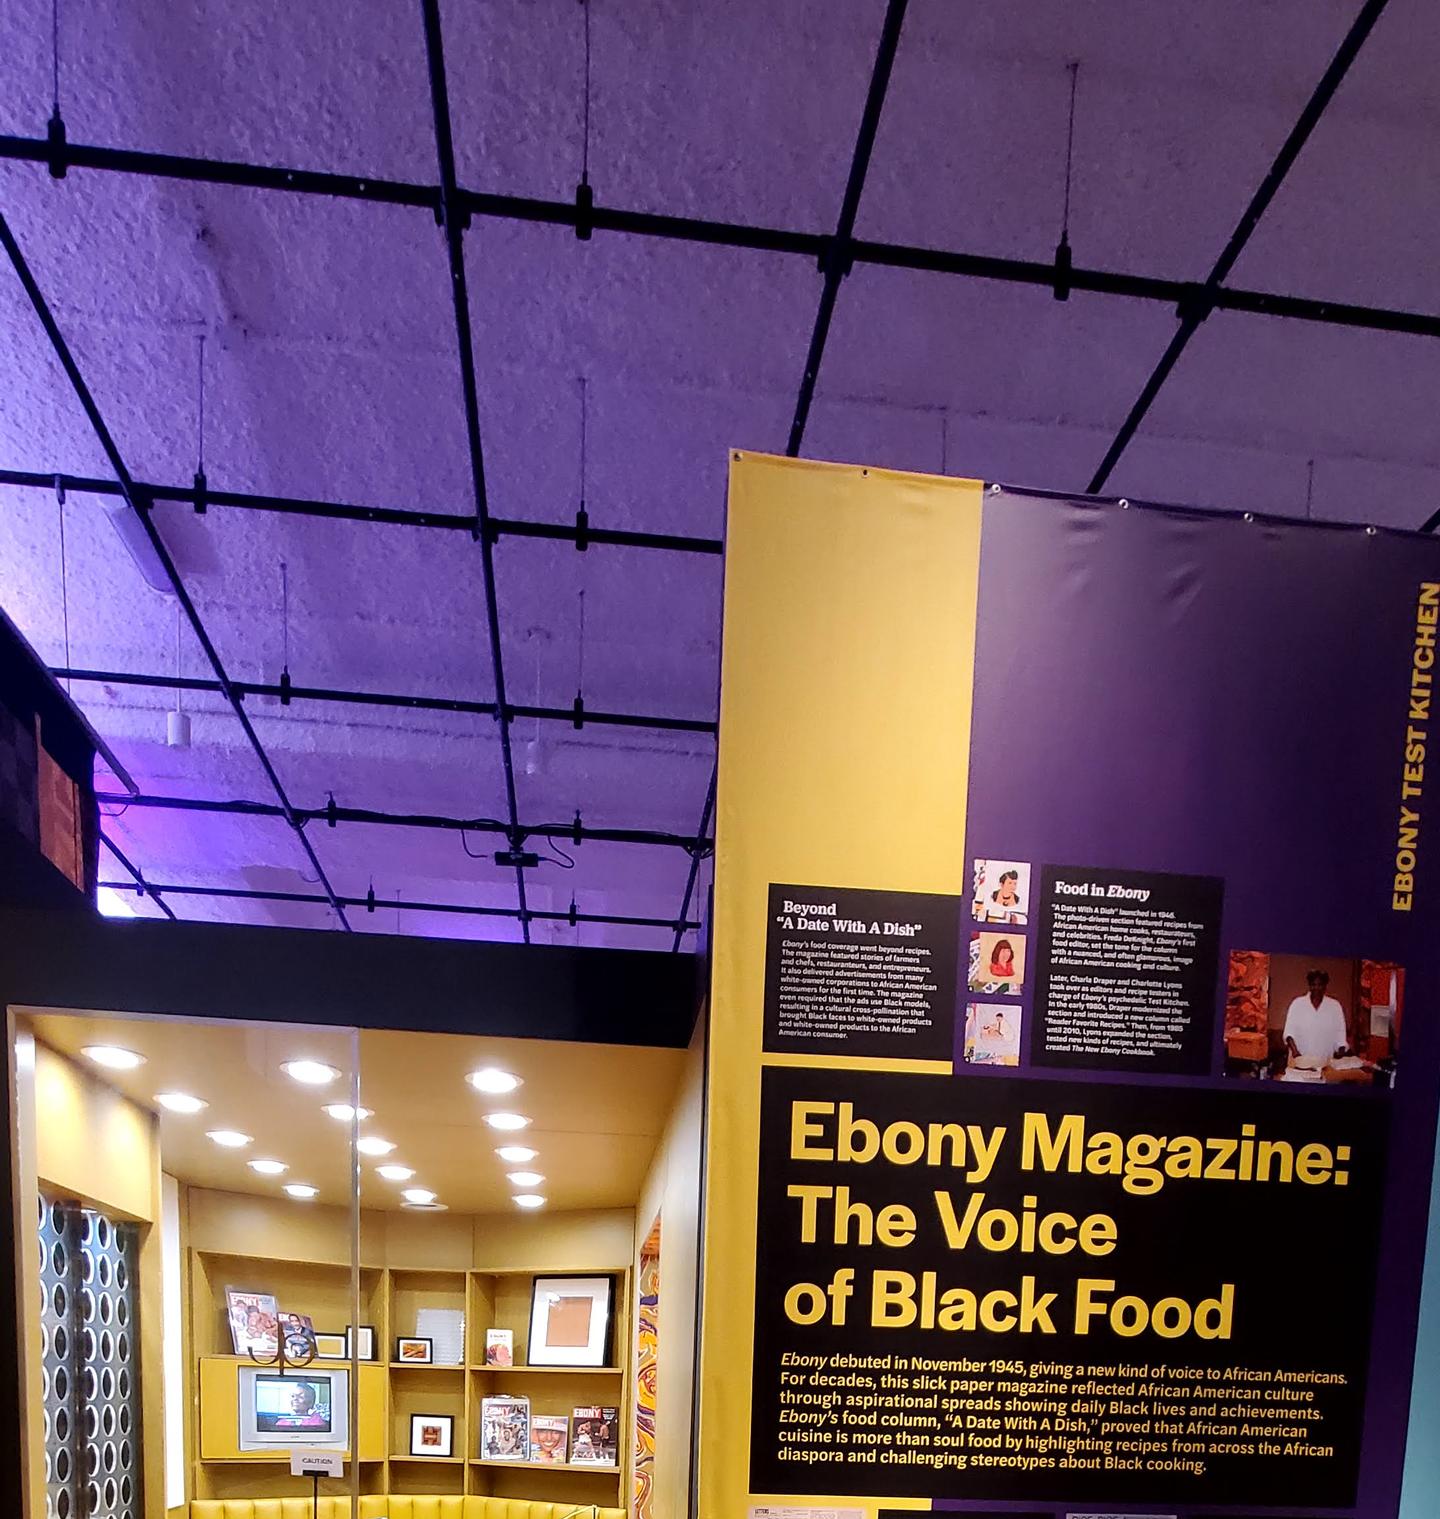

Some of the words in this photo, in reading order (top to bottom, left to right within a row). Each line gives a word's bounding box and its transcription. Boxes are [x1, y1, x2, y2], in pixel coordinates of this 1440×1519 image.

[1408, 582, 1440, 720] KITCHEN
[1402, 725, 1427, 800] TEST
[1392, 806, 1420, 912] EBONY
[1055, 881, 1088, 895] Food
[1090, 883, 1104, 896] in
[1106, 884, 1149, 902] Ebony
[784, 901, 836, 917] Beyond
[777, 916, 793, 928] “A
[797, 917, 829, 931] Date
[832, 920, 866, 933] With
[868, 922, 880, 934] A
[883, 923, 921, 936] Dish”
[782, 940, 808, 949] Ebony’s
[810, 941, 826, 949] food
[827, 944, 858, 952] coverage
[878, 945, 903, 954] beyond
[905, 947, 931, 955] recipes.
[830, 951, 859, 959] featured
[860, 953, 883, 961] stories
[893, 955, 919, 963] farmers
[781, 976, 824, 984] white-owned
[826, 979, 869, 987] corporations
[904, 982, 936, 990] American
[791, 1101, 1006, 1183] Ebony
[1022, 1112, 1350, 1199] Magazine:
[787, 1185, 916, 1247] The
[934, 1191, 1117, 1255] Voice
[784, 1268, 854, 1325] of
[871, 1270, 1058, 1333] Black
[1075, 1279, 1234, 1339] Food
[781, 1353, 827, 1371] Ebony
[830, 1355, 890, 1369] debuted
[894, 1357, 907, 1370] in
[911, 1357, 986, 1372] November
[988, 1360, 1026, 1375] 1945,
[1029, 1361, 1073, 1379] giving
[1075, 1366, 1083, 1375] a
[1087, 1366, 1115, 1376] new
[1118, 1364, 1147, 1377] kind
[1151, 1365, 1165, 1378] of
[1168, 1366, 1203, 1379] voice
[1207, 1367, 1220, 1380] to
[1223, 1367, 1270, 1381] African
[1274, 1369, 1346, 1384] Americans.
[781, 1373, 805, 1386] For
[809, 1374, 876, 1390] decades,
[880, 1376, 908, 1389] this
[912, 1377, 946, 1390] slick
[950, 1381, 994, 1395] paper
[997, 1380, 1067, 1396] magazine
[1071, 1382, 1134, 1395] reflected
[1138, 1383, 1189, 1397] African
[1193, 1385, 1260, 1399] American
[1265, 1387, 1313, 1400] culture
[574, 1408, 601, 1418] EBONY
[780, 1392, 840, 1410] through
[846, 1394, 937, 1411] aspirational
[941, 1398, 1000, 1413] spreads
[1004, 1399, 1067, 1416] showing
[1071, 1400, 1105, 1418] daily
[1110, 1401, 1148, 1415] Black
[1153, 1402, 1185, 1416] lives
[1190, 1404, 1215, 1417] and
[1220, 1405, 1322, 1420] achievements.
[780, 1410, 838, 1428] Ebony’s
[842, 1412, 876, 1425] food
[880, 1414, 940, 1429] column,
[945, 1415, 962, 1428] “A
[966, 1415, 1000, 1429] Date
[1004, 1416, 1036, 1430] With
[1040, 1417, 1050, 1430] A
[1054, 1418, 1097, 1433] Dish,”
[1101, 1420, 1149, 1436] proved
[1154, 1420, 1183, 1433] that
[1186, 1421, 1236, 1435] African
[1240, 1423, 1306, 1437] American
[778, 1430, 832, 1443] cuisine
[836, 1431, 848, 1444] is
[852, 1435, 891, 1445] more
[895, 1432, 929, 1446] than
[933, 1434, 963, 1446] soul
[968, 1434, 1001, 1447] food
[1005, 1435, 1022, 1452] by
[1026, 1436, 1112, 1454] highlighting
[1116, 1439, 1167, 1455] recipes
[1172, 1439, 1204, 1452] from
[1209, 1444, 1254, 1454] across
[1258, 1442, 1280, 1454] the
[1283, 1442, 1332, 1456] African
[302, 1457, 333, 1465] CAUTION
[778, 1449, 843, 1466] diaspora
[847, 1451, 876, 1463] and
[880, 1452, 967, 1470] challenging
[970, 1454, 1054, 1472] stereotypes
[1059, 1456, 1100, 1469] about
[1105, 1457, 1142, 1470] Black
[1147, 1459, 1205, 1476] cooking.
